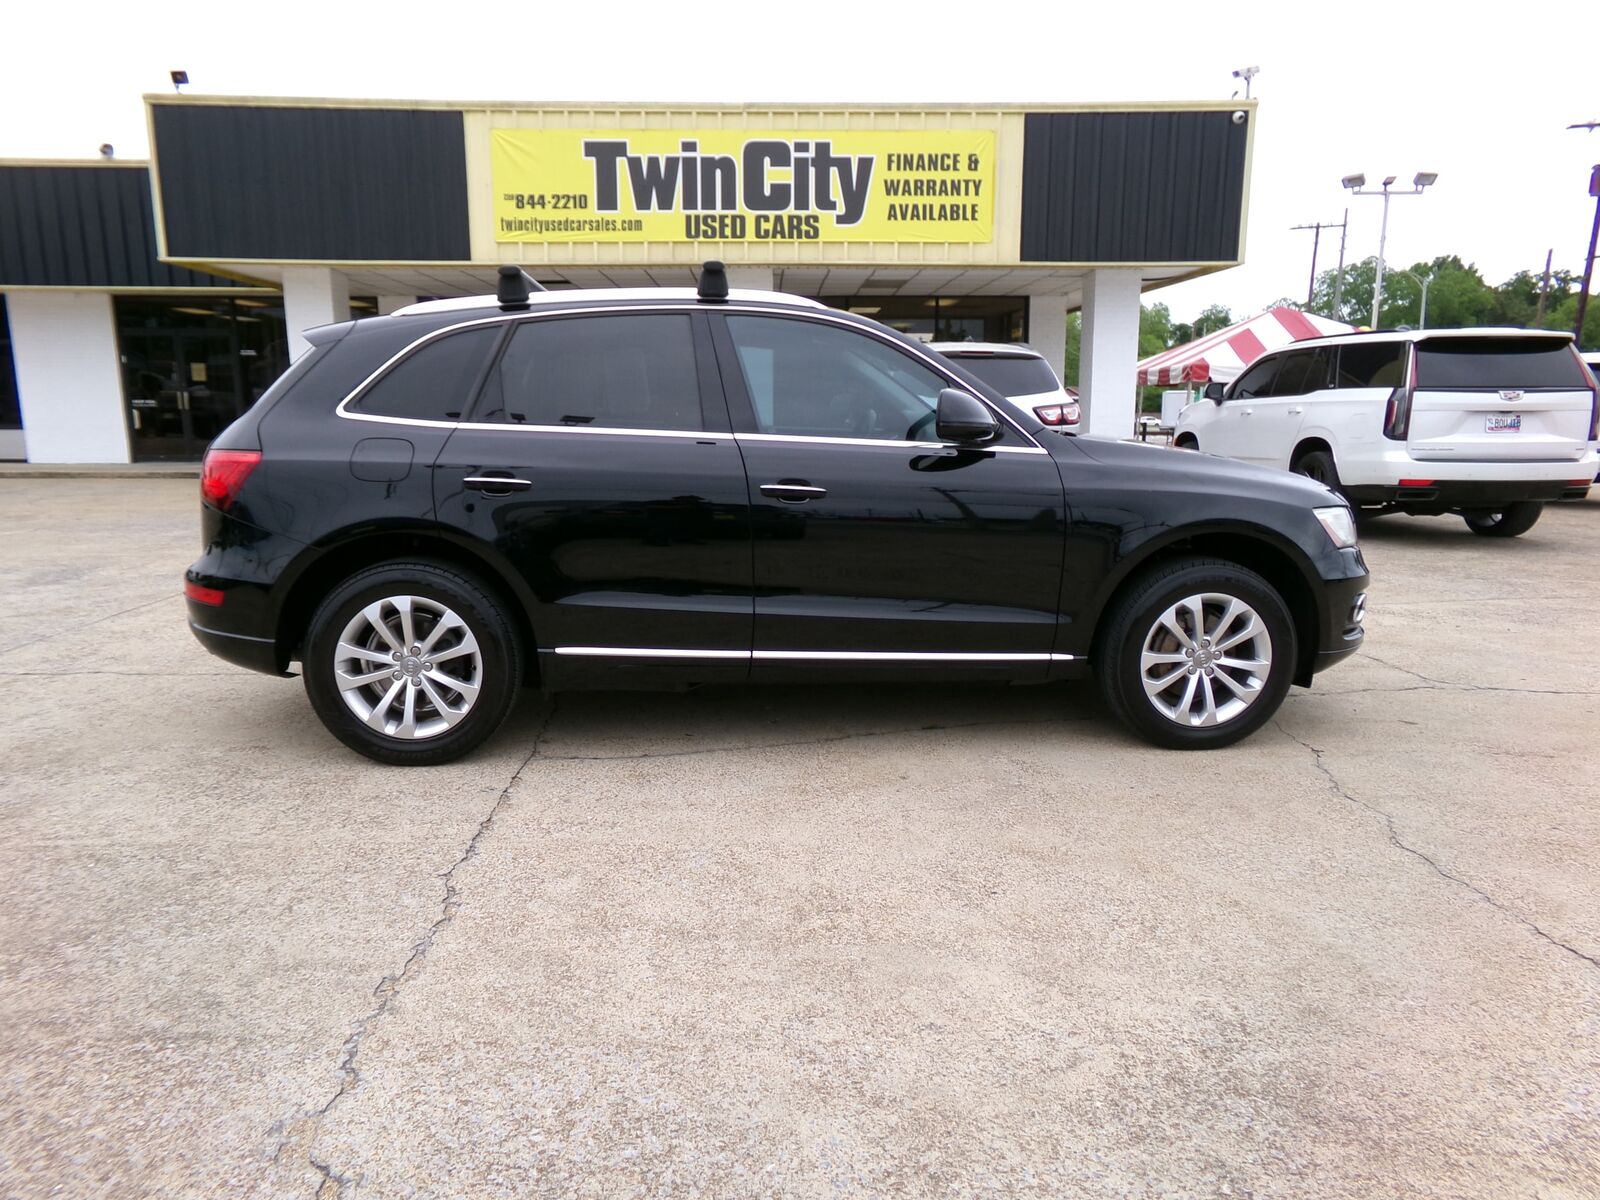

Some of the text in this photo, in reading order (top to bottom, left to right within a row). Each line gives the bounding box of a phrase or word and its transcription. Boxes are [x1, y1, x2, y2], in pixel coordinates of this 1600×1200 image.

[887, 153, 980, 172] FINANCE &
[883, 178, 983, 197] WARRANTY
[887, 203, 980, 221] AVAILABLE
[500, 216, 643, 234] twincityusedcarsales.com
[685, 214, 820, 239] USED CARS
